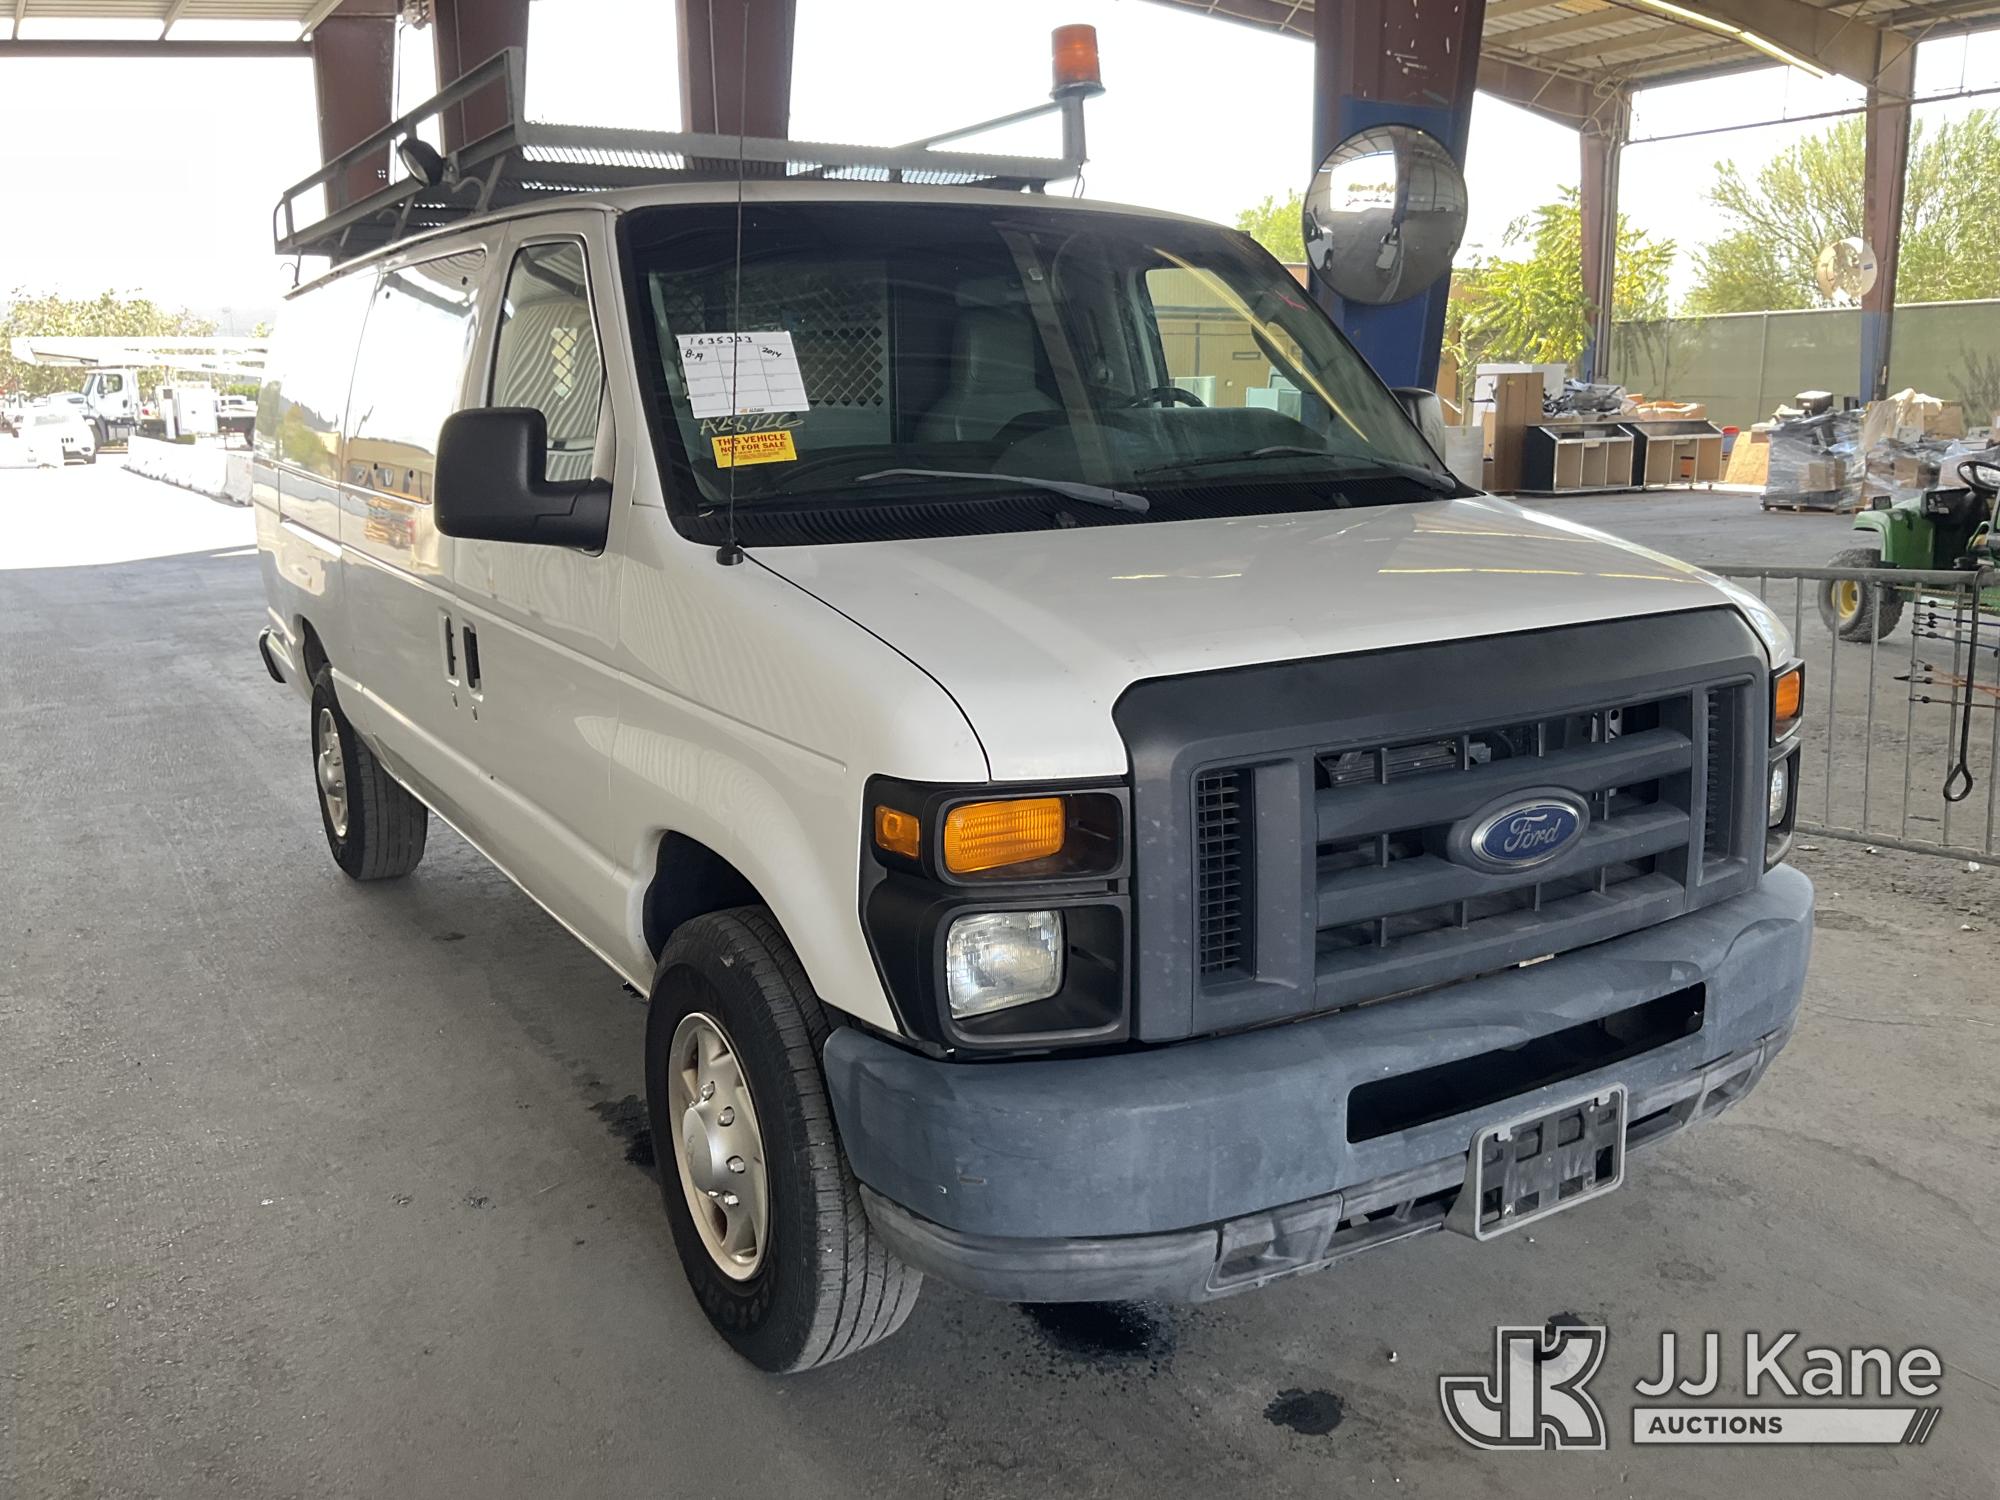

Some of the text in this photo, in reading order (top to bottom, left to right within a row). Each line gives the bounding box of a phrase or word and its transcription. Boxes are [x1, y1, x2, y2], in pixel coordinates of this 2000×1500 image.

[761, 347, 782, 357] 2014
[717, 433, 786, 446] THS VEHICLE
[742, 443, 759, 451] FOR
[762, 441, 784, 449] SALE
[1504, 814, 1561, 852] Ford
